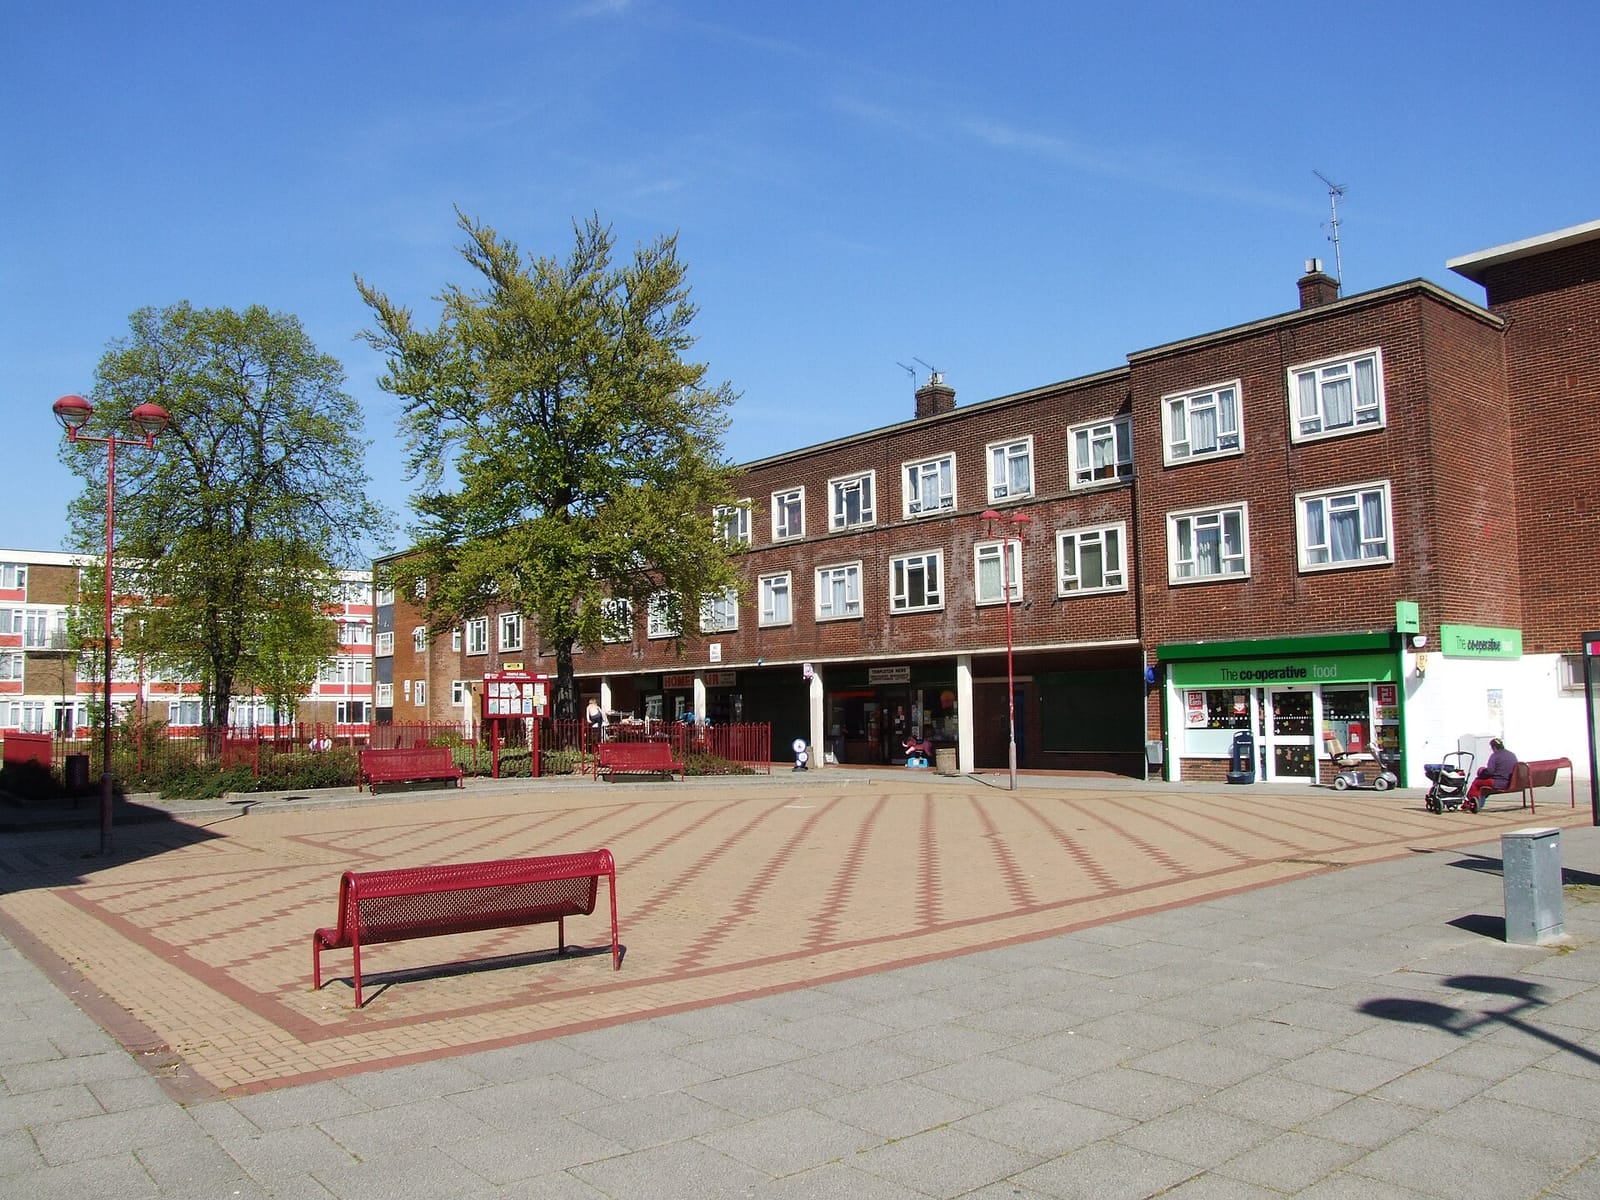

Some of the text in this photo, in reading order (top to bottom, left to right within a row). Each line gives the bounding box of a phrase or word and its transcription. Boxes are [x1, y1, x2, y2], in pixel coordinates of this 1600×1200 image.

[1467, 638, 1501, 654] co-operative
[1220, 663, 1337, 681] The co-operative food
